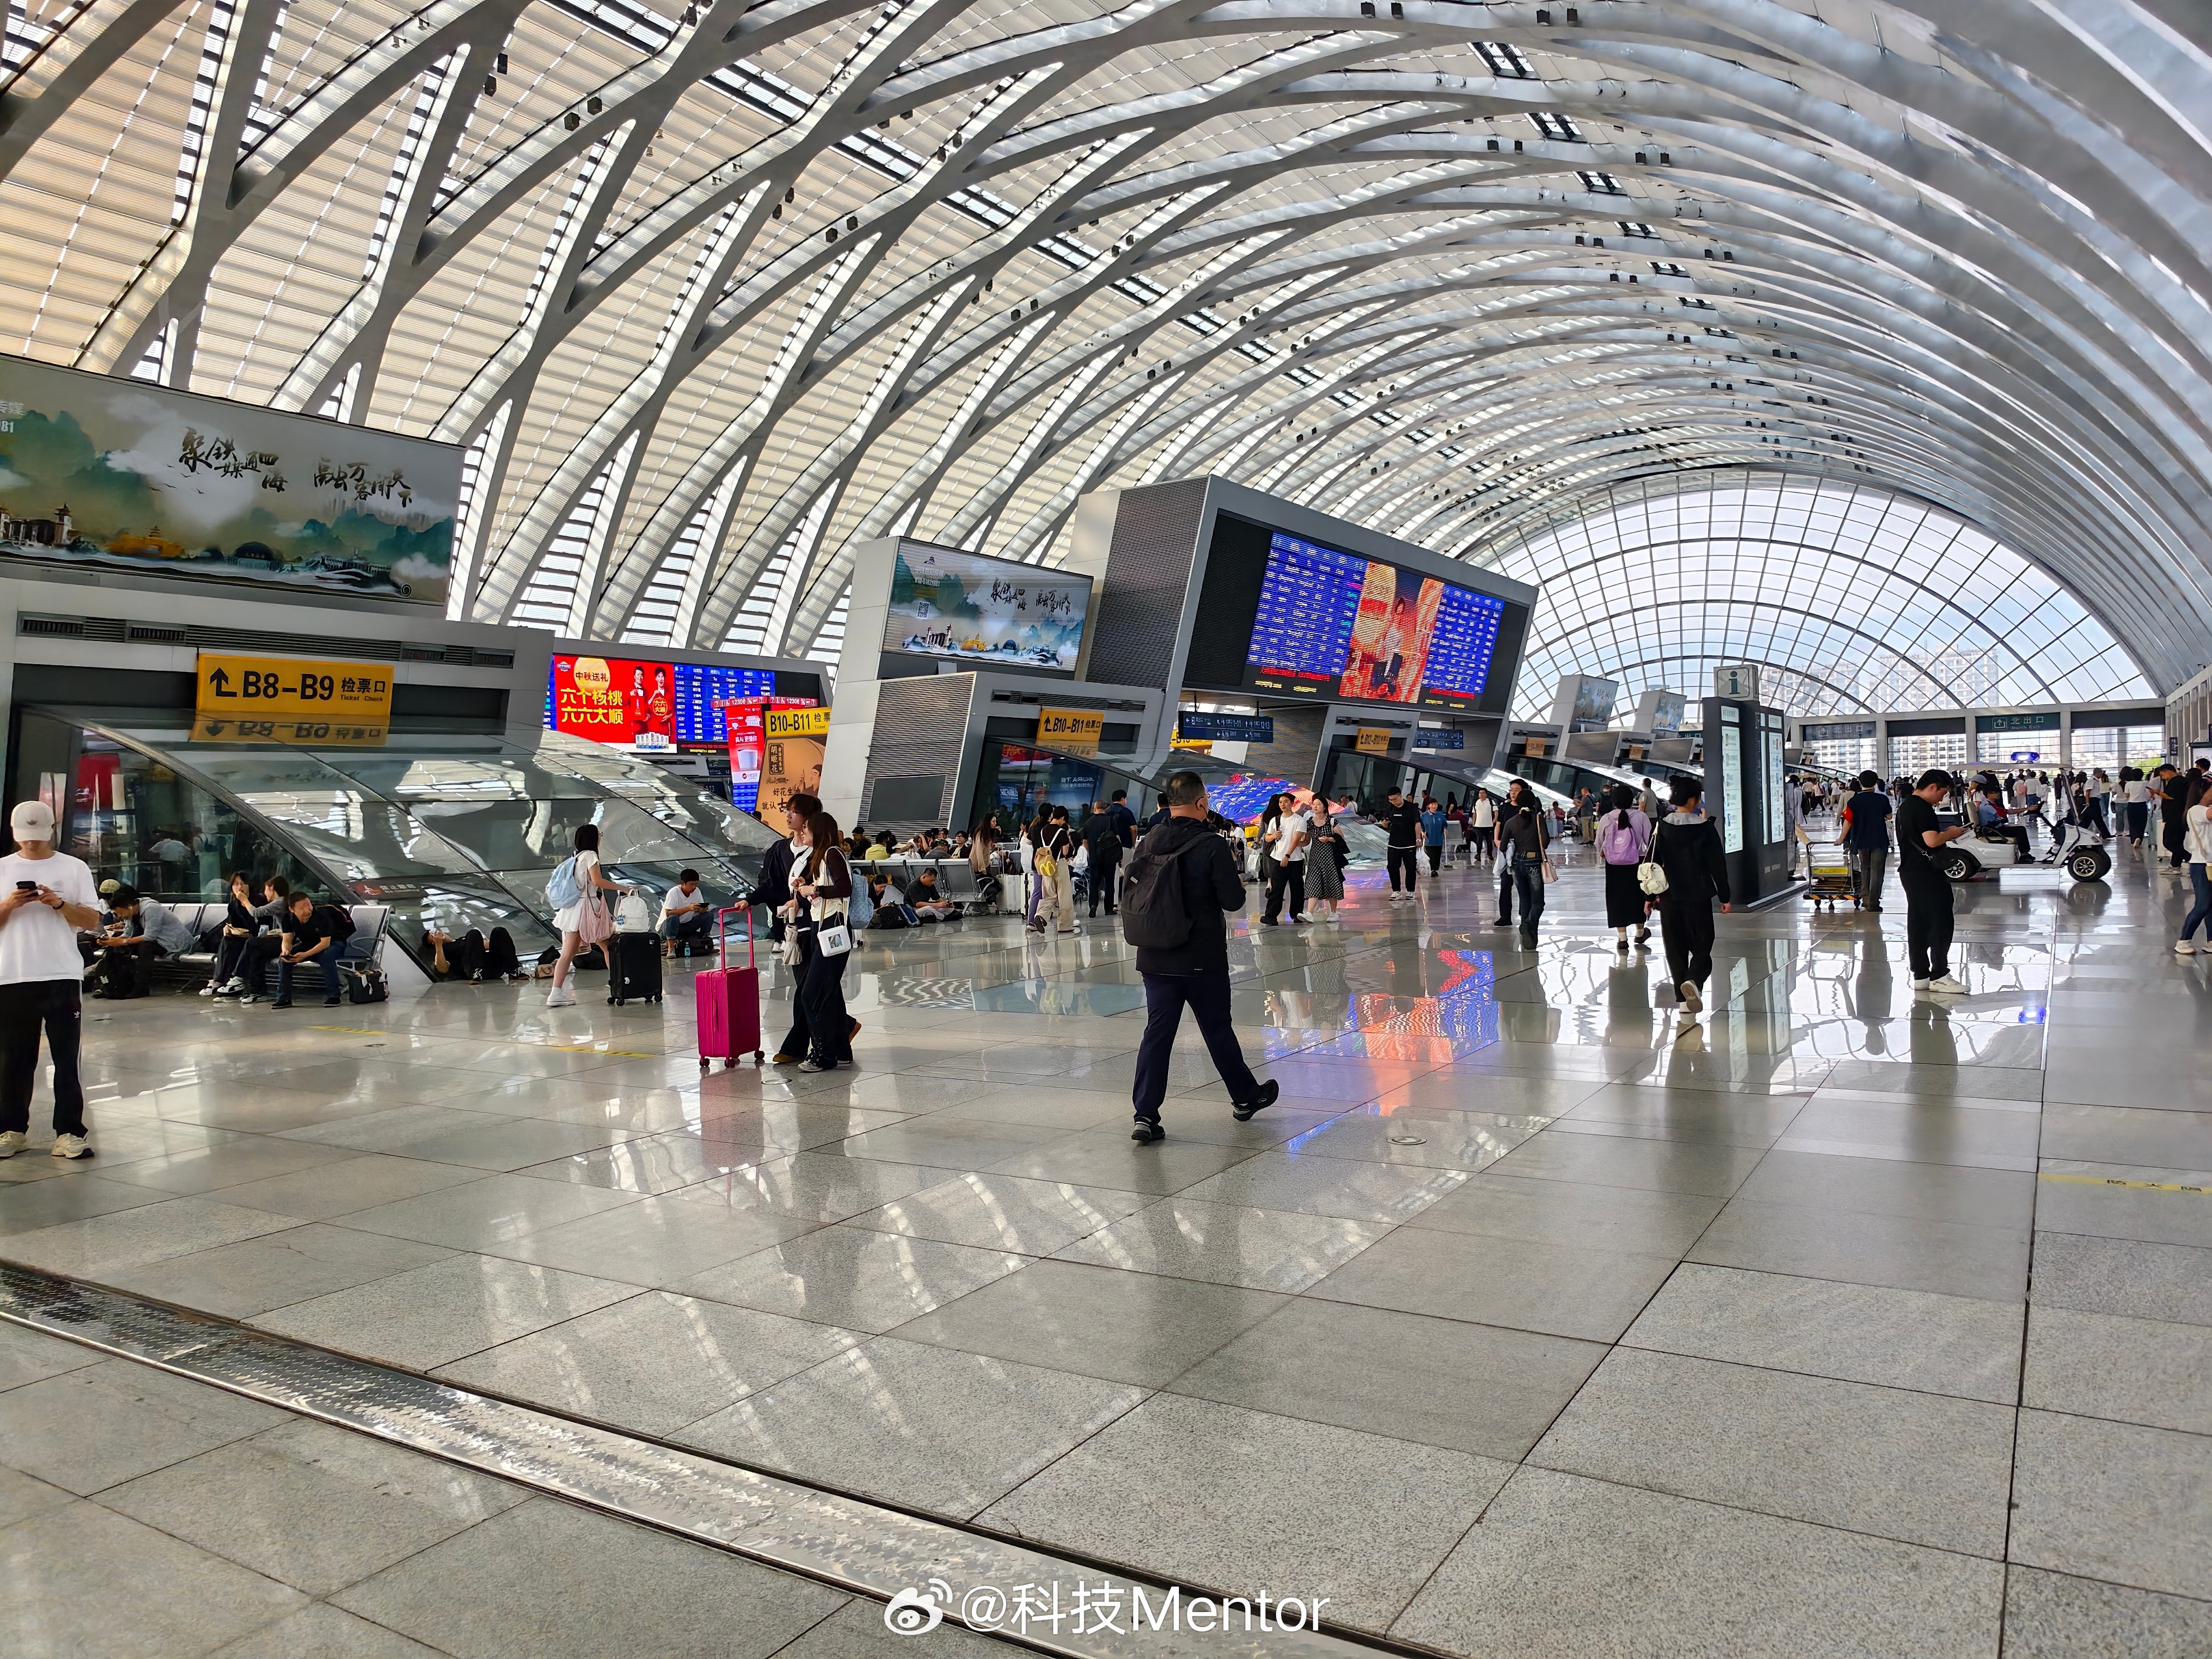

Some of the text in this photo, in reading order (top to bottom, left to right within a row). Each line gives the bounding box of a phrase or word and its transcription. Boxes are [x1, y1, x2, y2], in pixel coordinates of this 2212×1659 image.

[0, 421, 14, 433] 81
[575, 672, 609, 682] 中秋送礼
[242, 671, 334, 701] B8-B9
[341, 677, 386, 694] 检票口
[560, 687, 623, 706] 六个核桃
[561, 706, 623, 724] 六六大顺
[770, 713, 811, 732] B10-B11
[2011, 716, 2044, 725] 北出口
[1053, 717, 1084, 733] B10-B11
[1833, 725, 1863, 733] 北出口
[773, 787, 801, 797] 好花生油
